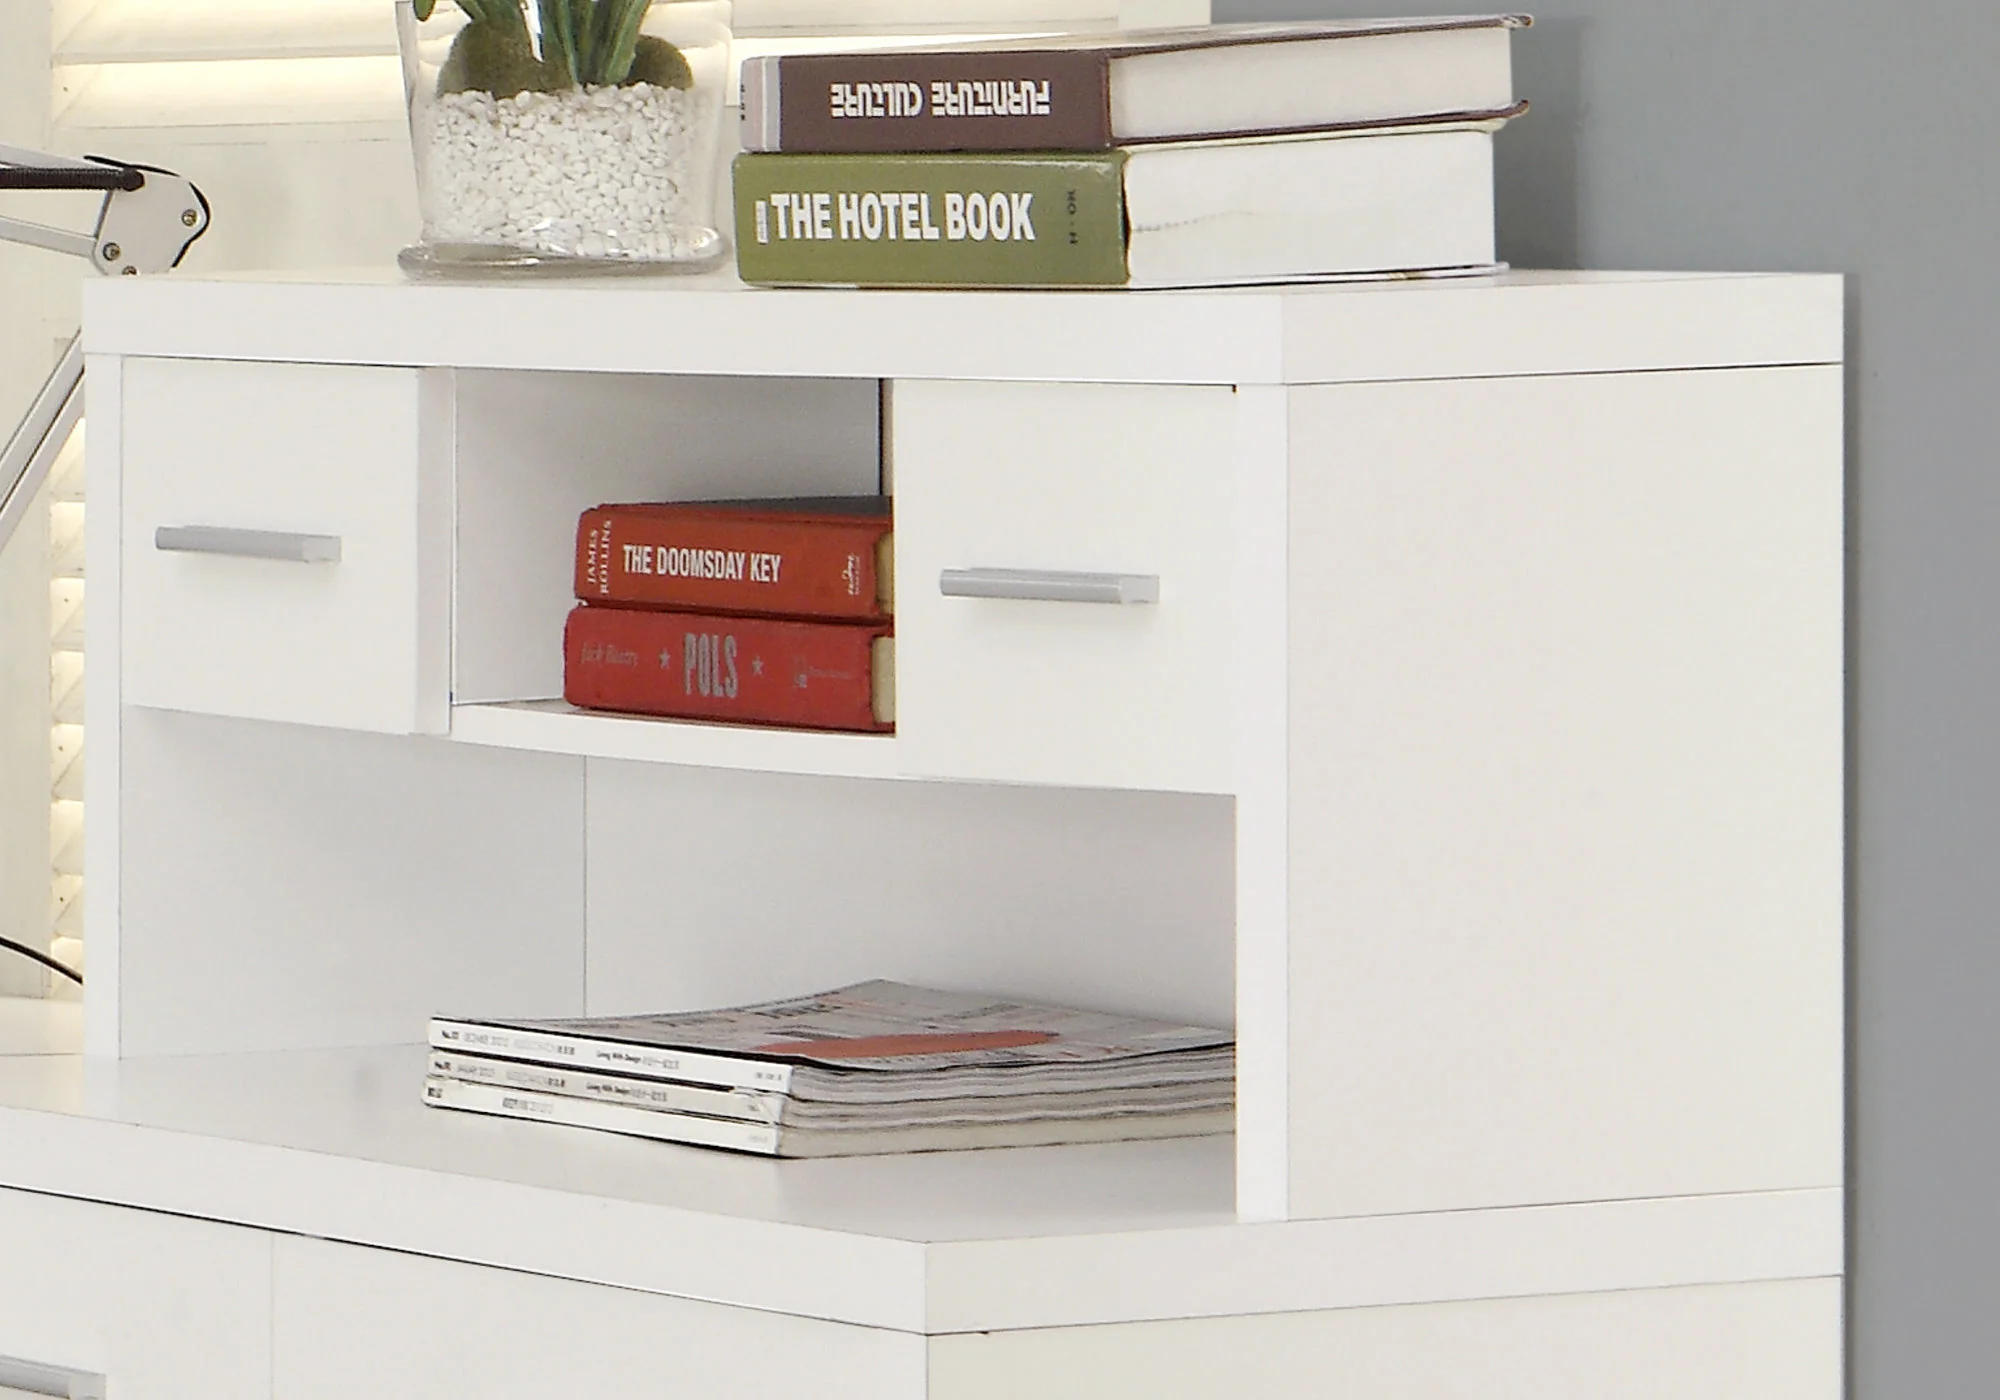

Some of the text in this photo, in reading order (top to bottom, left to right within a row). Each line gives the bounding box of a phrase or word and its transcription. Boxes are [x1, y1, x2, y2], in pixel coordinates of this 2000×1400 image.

[829, 80, 1051, 118] FURNITURE CULTURE
[770, 192, 833, 240] THE
[838, 192, 940, 241] HOTEL
[944, 192, 1036, 241] BOOK
[586, 529, 599, 584] JAMES
[599, 519, 613, 595] ROLLINS
[622, 544, 782, 584] THE DOOMSDAY KEY
[684, 632, 738, 699] POLS
